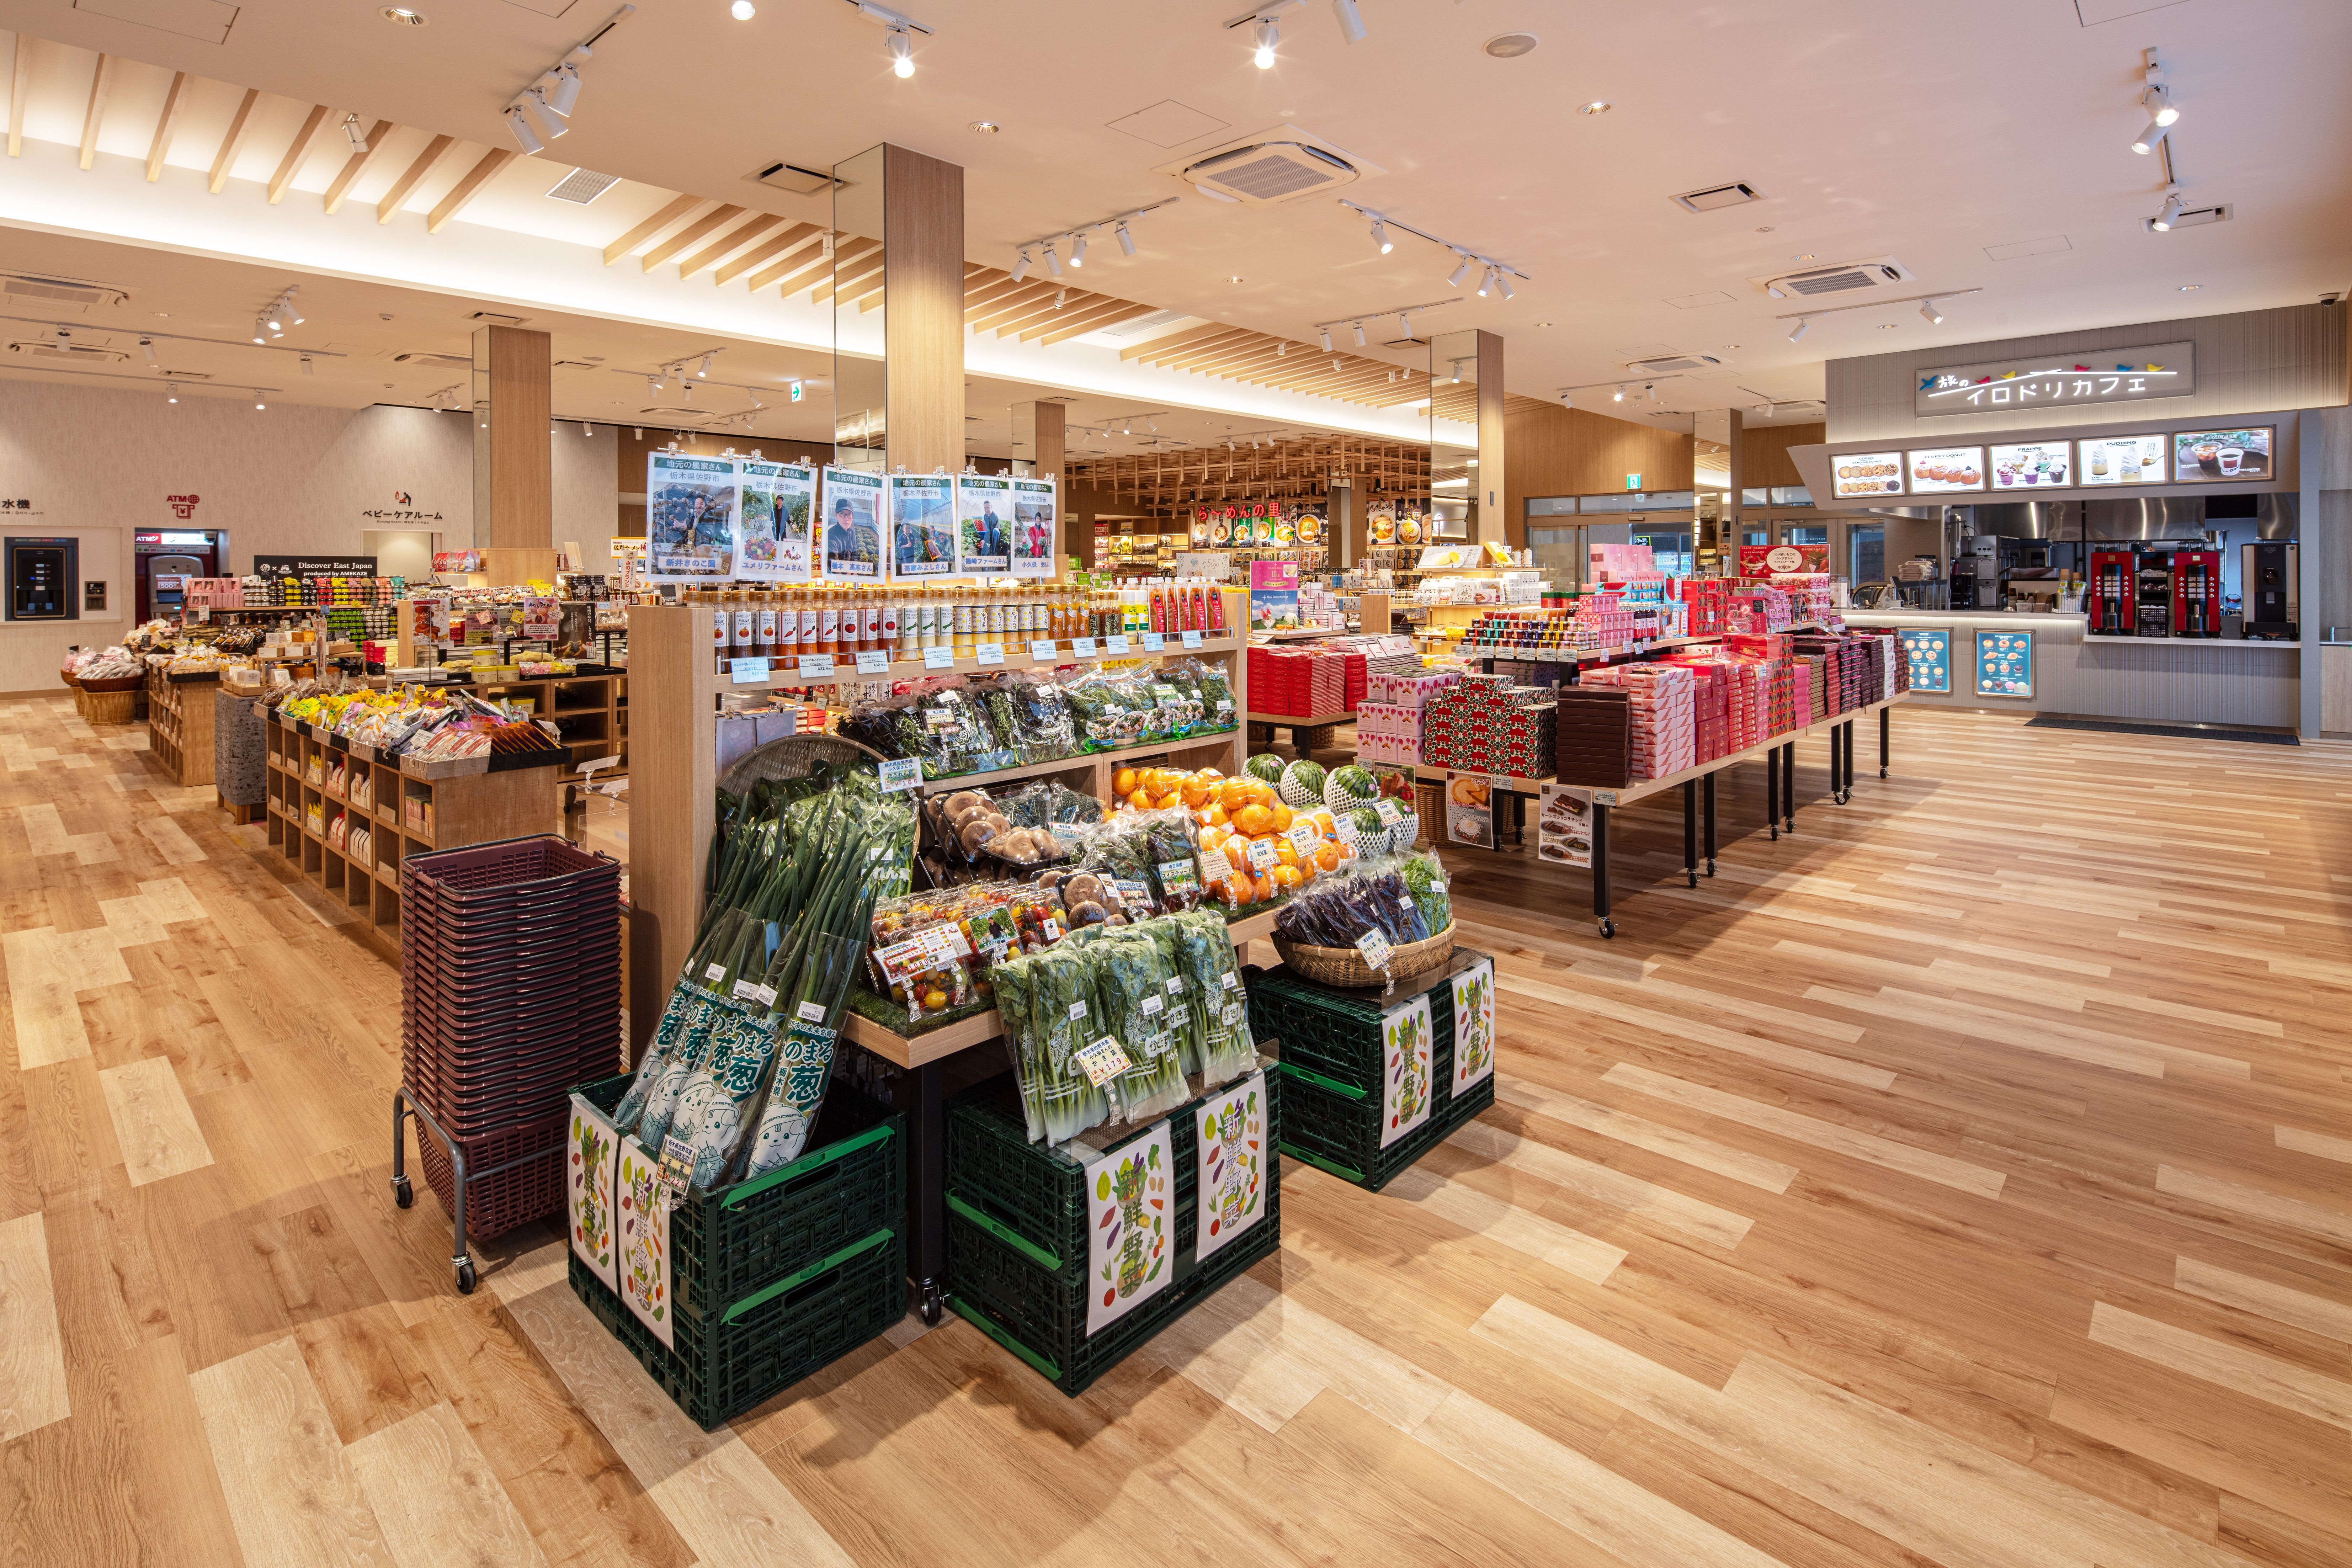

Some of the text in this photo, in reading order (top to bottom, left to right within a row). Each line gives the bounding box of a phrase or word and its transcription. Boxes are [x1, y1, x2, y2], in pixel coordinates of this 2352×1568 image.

[1938, 375, 1969, 388] 旅の
[1967, 377, 2146, 405] イロドリカフェ
[666, 459, 722, 471] 地元の農家さん
[669, 471, 720, 482] 栃木県佐野市
[754, 466, 800, 478] 地元の農家さん
[835, 473, 874, 486] 地元の農家さん
[903, 478, 942, 487] 地元の農家さん
[968, 479, 1002, 488] 地元の農家さん
[756, 481, 798, 492] 栃木県佐野市
[836, 486, 872, 498] 栃木県佐野市
[969, 489, 1000, 498] 栃木県佐野市
[0, 499, 30, 509] 水機
[363, 510, 442, 520] ベビーケアルーム
[666, 558, 716, 568] 新井きのこ園
[742, 562, 803, 572] ユメリファームさん
[832, 562, 873, 573] 橋本 高志さん
[884, 759, 914, 767] 栃木県佐野市産
[888, 764, 913, 772] 小久保さんの
[888, 770, 914, 779] ほうれん草
[1448, 801, 1490, 812] いちご畑のチーズケーキ
[1541, 812, 1582, 823] カーンズショコラサンド
[1343, 828, 1355, 837] ¥780
[1303, 841, 1317, 850] ¥580
[1162, 867, 1192, 879] スイスチャード
[1363, 934, 1374, 943] 埼玉県産
[1364, 942, 1377, 953] からし菜
[1374, 947, 1388, 958] ¥120
[887, 949, 922, 964] カラフルミニトマト
[1468, 986, 1481, 1075] 新鮮野菜
[1082, 1039, 1110, 1057] 栃木県佐野市産
[1089, 1045, 1112, 1060] 小久保さんの
[1099, 1057, 1122, 1074] ¥179
[723, 1054, 763, 1094] 葱
[1401, 1025, 1417, 1125] 新鮮野菜
[786, 1064, 825, 1103] 葱
[668, 1139, 693, 1156] 栃木県佐野市産
[668, 1148, 689, 1161] 小久保さんの
[1224, 1108, 1242, 1229] 新鮮野菜
[664, 1173, 685, 1190] ¥229
[584, 1134, 597, 1259] 新鮮野菜
[1120, 1164, 1143, 1297] 新鮮野菜
[635, 1176, 649, 1311] 新鮮野菜
